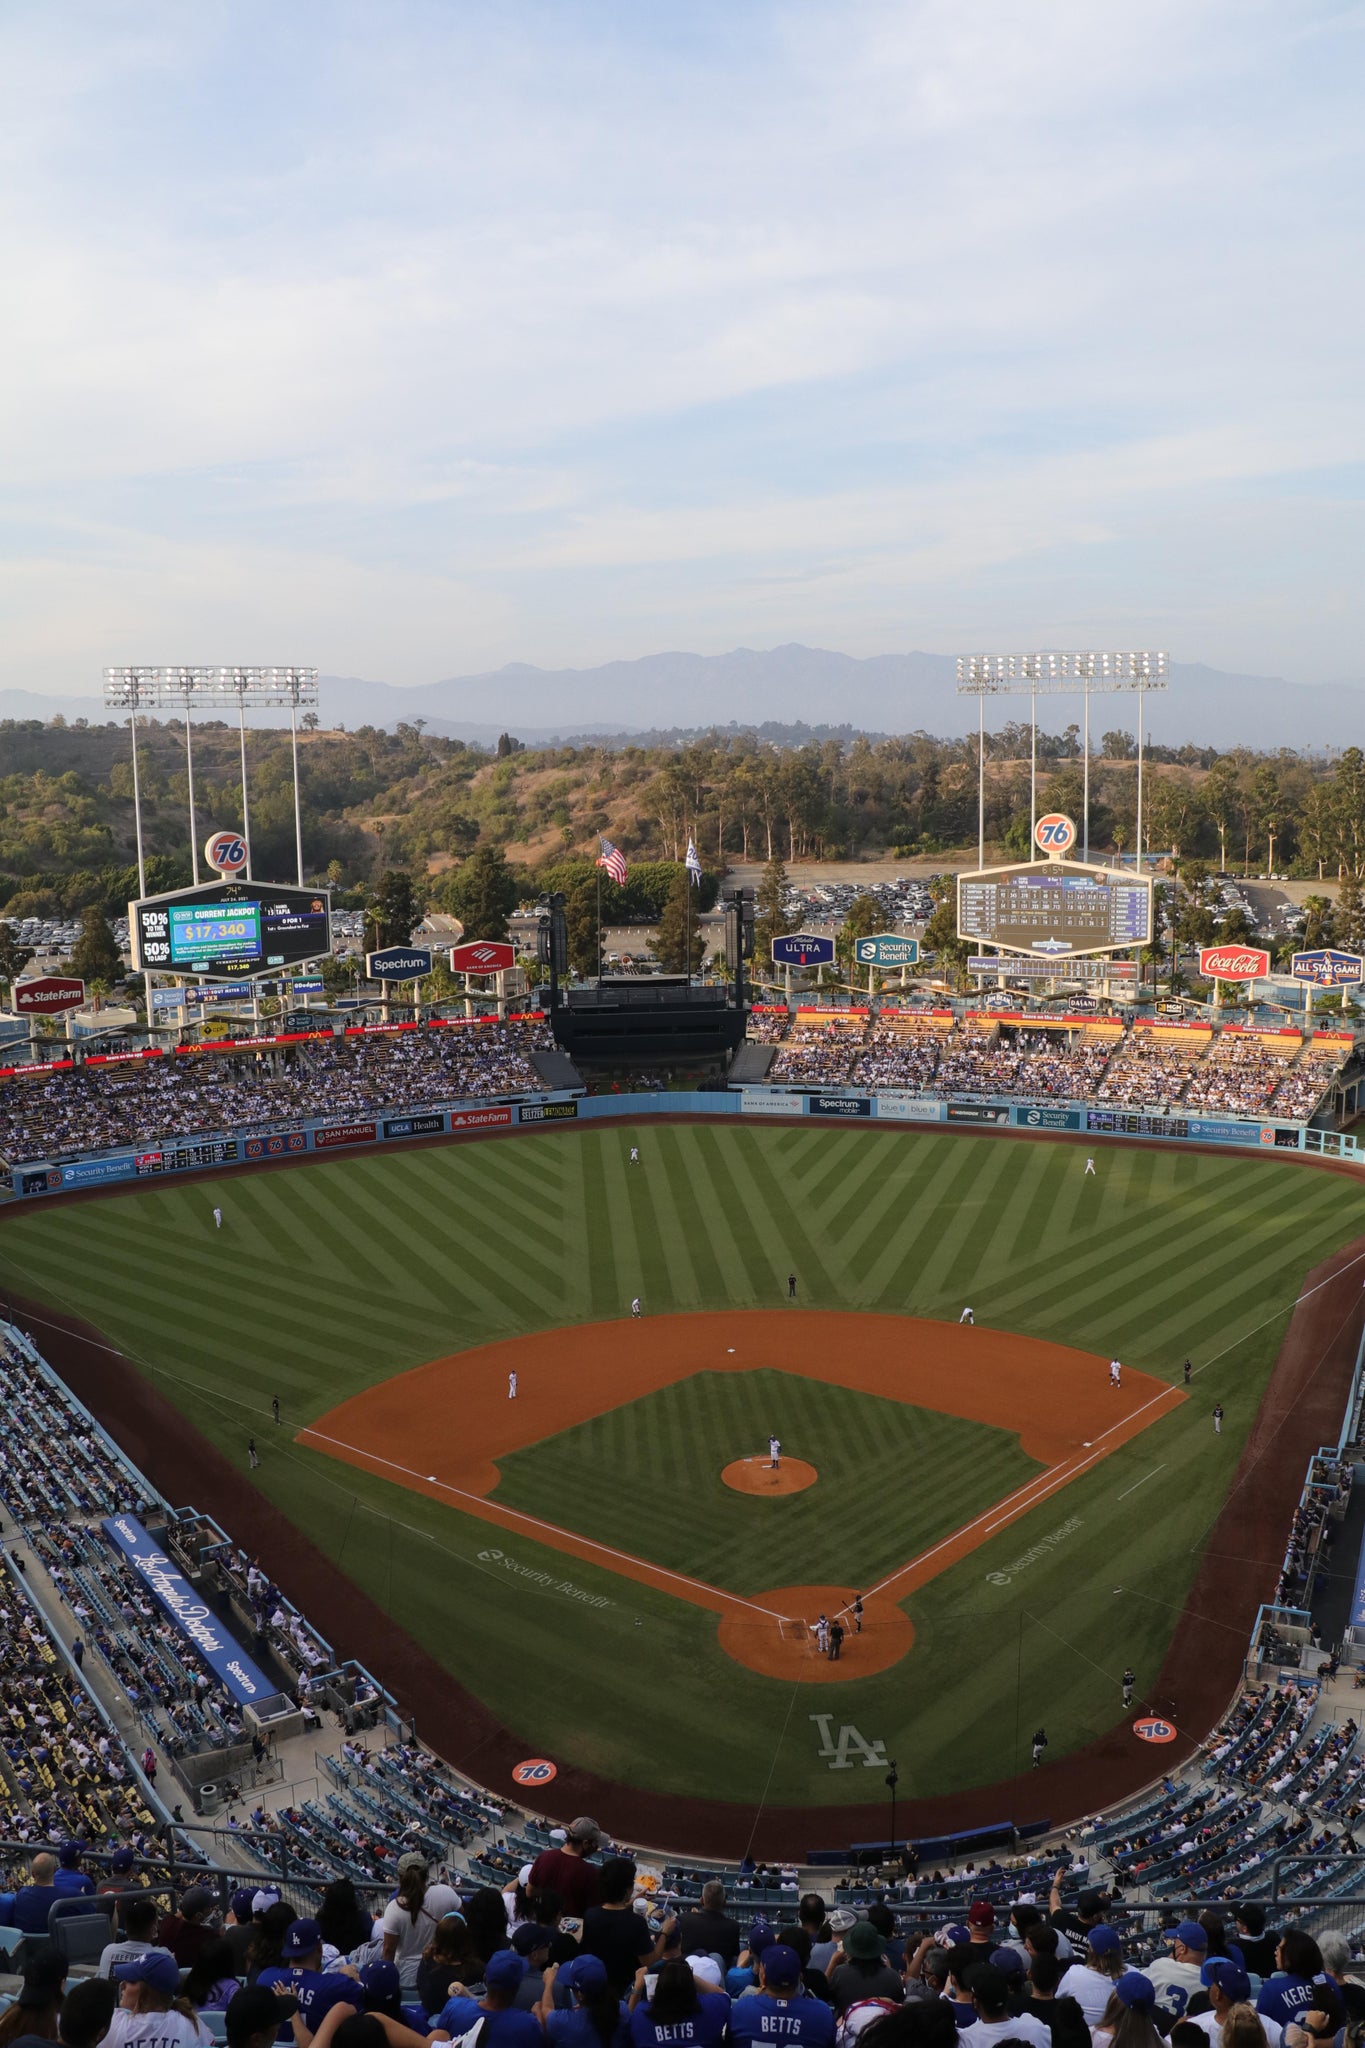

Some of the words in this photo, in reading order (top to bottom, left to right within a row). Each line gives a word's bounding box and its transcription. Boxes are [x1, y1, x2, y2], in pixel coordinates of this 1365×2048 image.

[1040, 822, 1068, 845] 76
[216, 840, 245, 864] 76
[142, 913, 168, 926] 50%
[195, 910, 226, 919] CURRENT
[227, 908, 255, 916] JACKPOT
[144, 942, 170, 956] 50%
[786, 943, 820, 952] ULTRA
[880, 943, 912, 953] Security
[880, 952, 908, 960] Benefit
[1206, 953, 1262, 973] Coca-Cola
[374, 958, 424, 971] Spectrum
[1334, 964, 1360, 974] GAME
[819, 1099, 857, 1109] Spectrum
[522, 1111, 544, 1120] SELTZER
[325, 1129, 341, 1138] SAN
[342, 1126, 373, 1136] MANUEL
[392, 1124, 409, 1132] UCLA
[414, 1120, 440, 1131] Health
[1202, 1125, 1230, 1135] Security
[1232, 1128, 1257, 1137] Benefit
[1263, 1132, 1273, 1140] 76
[250, 1143, 260, 1152] 76
[271, 1140, 281, 1149] 76
[291, 1137, 302, 1147] 76
[76, 1166, 105, 1177] Security
[106, 1162, 131, 1172] Benefit
[49, 1174, 60, 1184] 76
[114, 1520, 137, 1543] Spectrum
[1002, 1543, 1054, 1574] Security
[1042, 1516, 1085, 1544] Benefit
[498, 1557, 558, 1586] Security
[556, 1581, 609, 1608] Benefit
[132, 1552, 168, 1575] Los
[150, 1573, 190, 1610] Angeles
[176, 1606, 224, 1652] Dodgers
[226, 1660, 256, 1694] Spectrum
[1139, 1722, 1170, 1738] 76
[809, 1713, 888, 1769] LA
[518, 1762, 551, 1780] 76
[292, 1933, 300, 1945] LA
[1281, 1985, 1313, 2008] KERS
[655, 2022, 693, 2042] BETTS
[761, 2016, 801, 2035] BETTS
